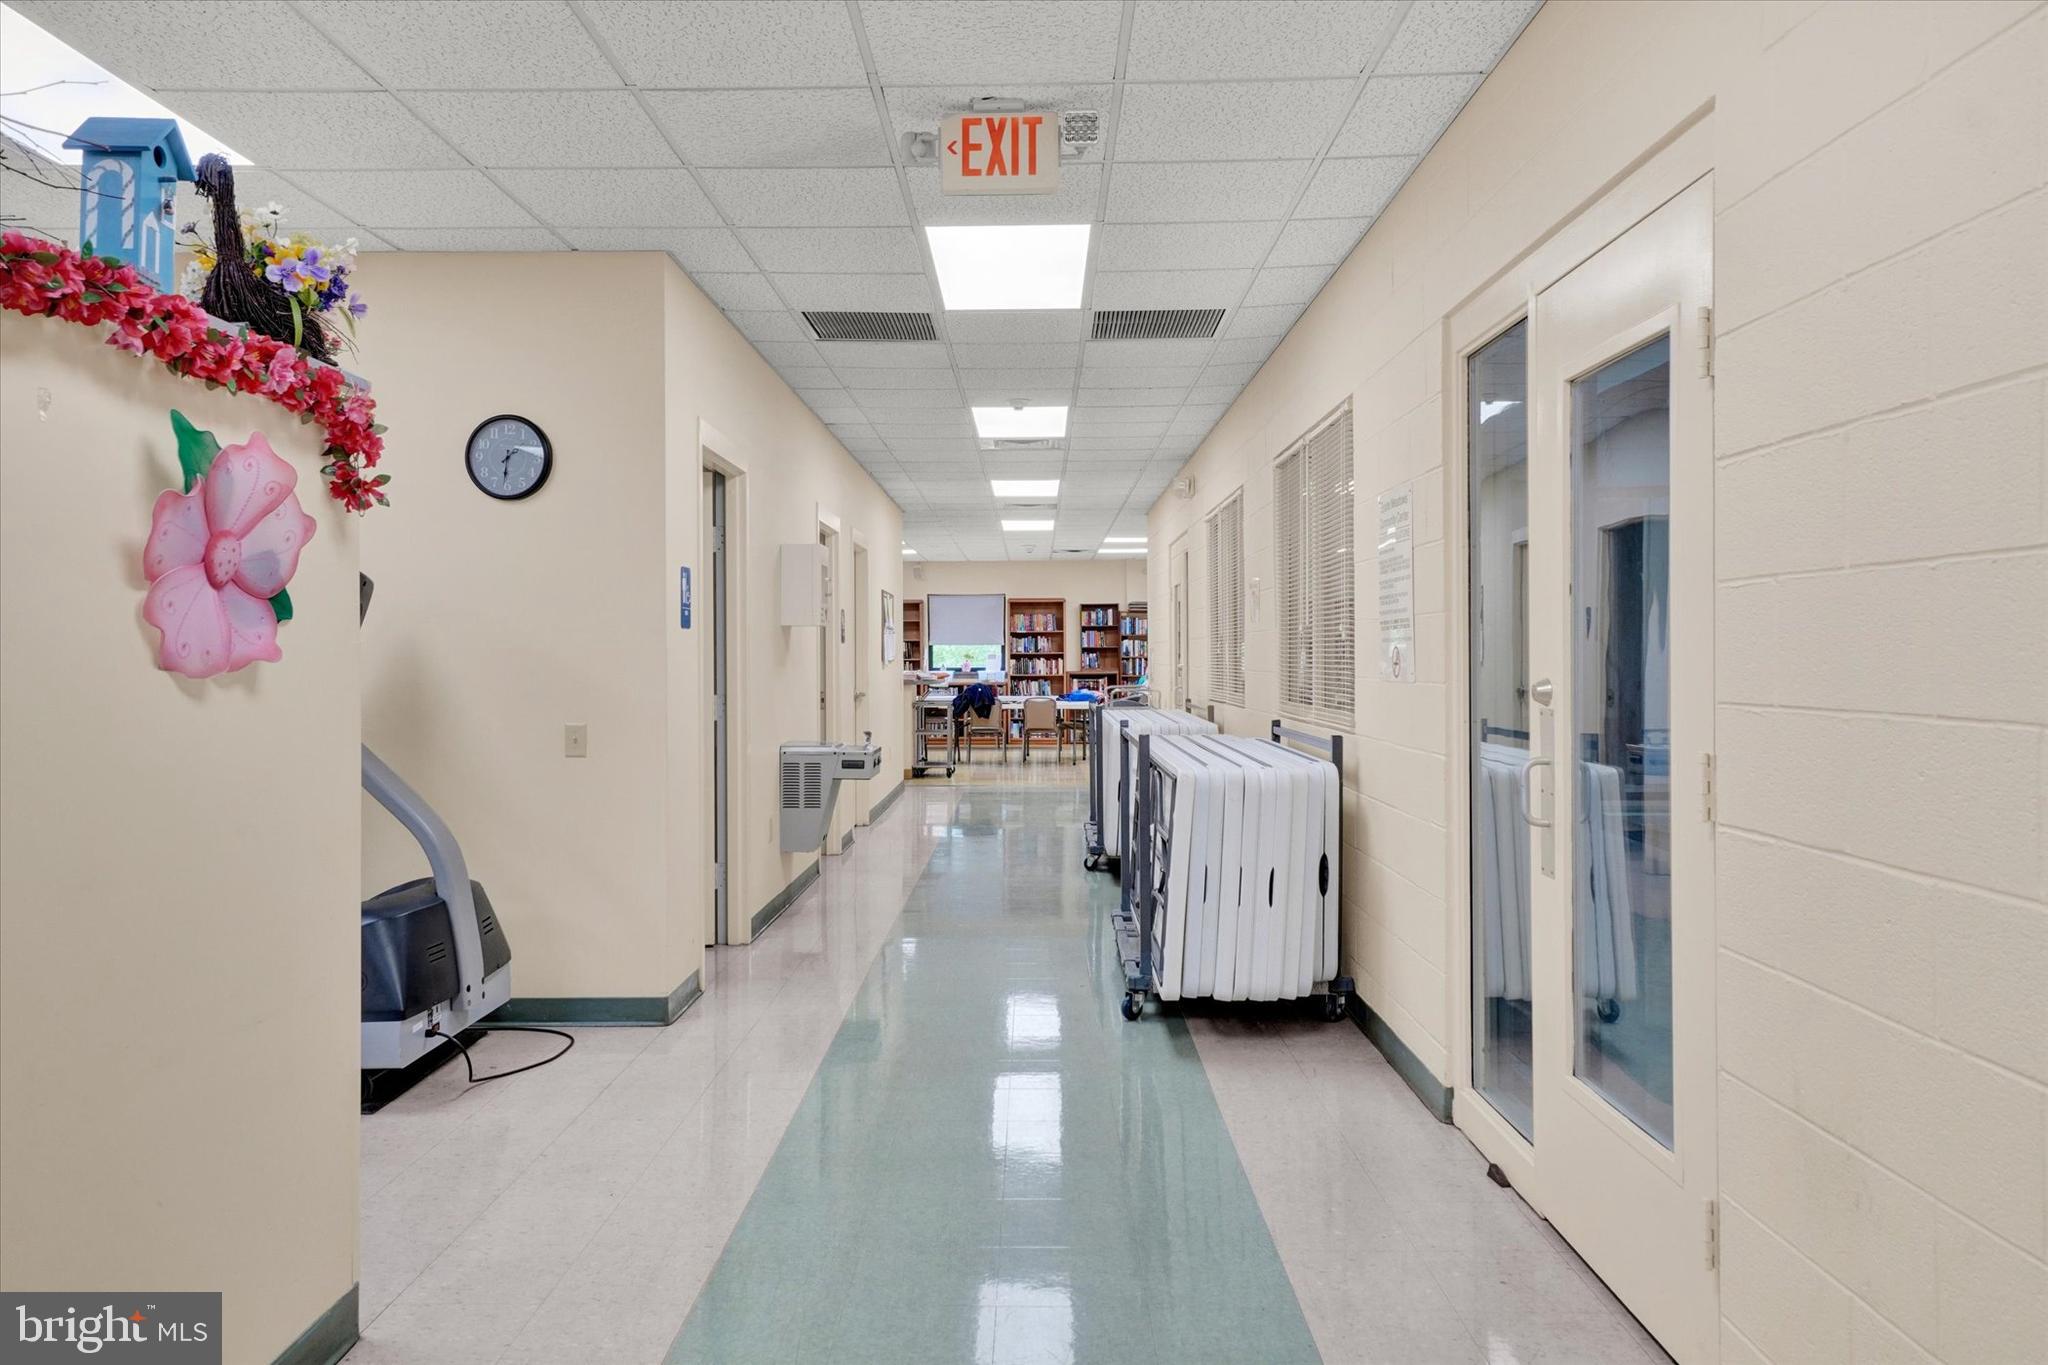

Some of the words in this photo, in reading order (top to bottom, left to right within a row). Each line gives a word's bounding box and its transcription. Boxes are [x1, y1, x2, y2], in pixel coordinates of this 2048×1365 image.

[961, 116, 1043, 177] EXIT
[491, 428, 498, 439] 11
[504, 424, 516, 434] 12
[520, 428, 525, 440] 1
[479, 439, 490, 449] 10
[475, 452, 483, 461] 9
[480, 467, 488, 477] 8
[491, 477, 498, 488] 7
[503, 481, 512, 491] 6
[519, 477, 525, 488] 5
